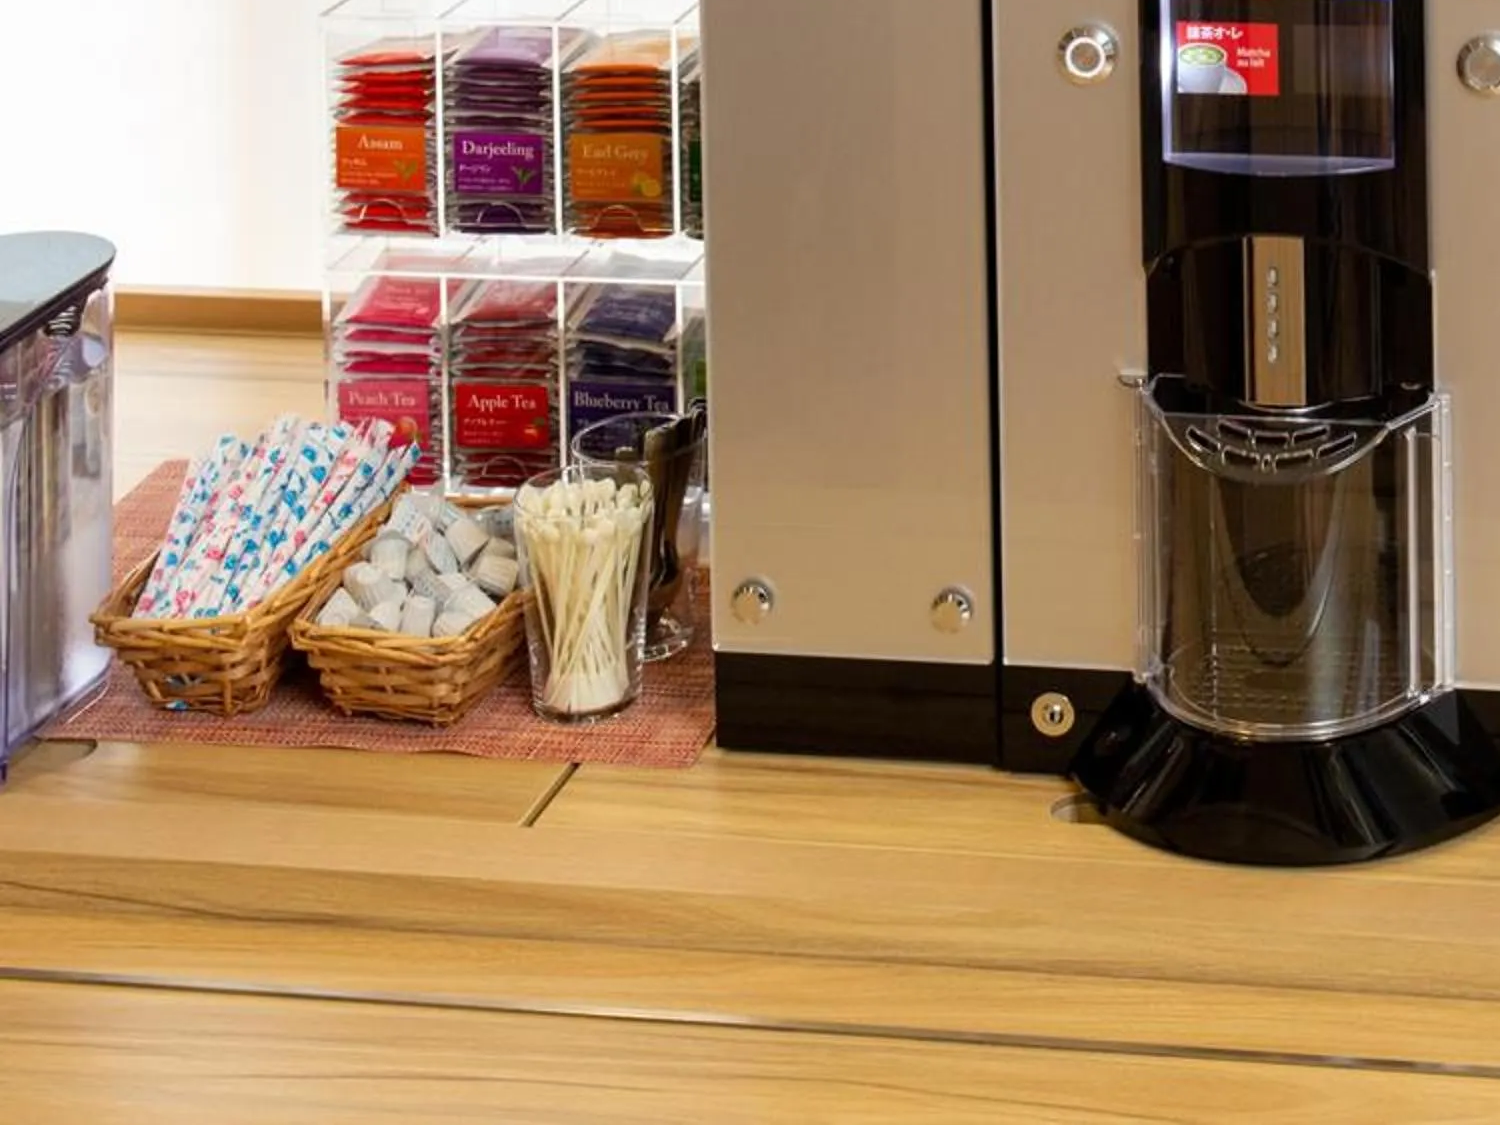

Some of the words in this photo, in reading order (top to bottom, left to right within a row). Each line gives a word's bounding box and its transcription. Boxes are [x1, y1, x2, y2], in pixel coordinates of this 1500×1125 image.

[357, 133, 403, 150] Assam
[461, 139, 535, 161] Darjeeling
[582, 144, 611, 158] Earl
[348, 390, 388, 406] Peach
[390, 390, 417, 407] Tea
[466, 394, 509, 413] Apple
[510, 394, 537, 410] Tea
[574, 391, 639, 410] Blueberry
[643, 394, 669, 411] Tea
